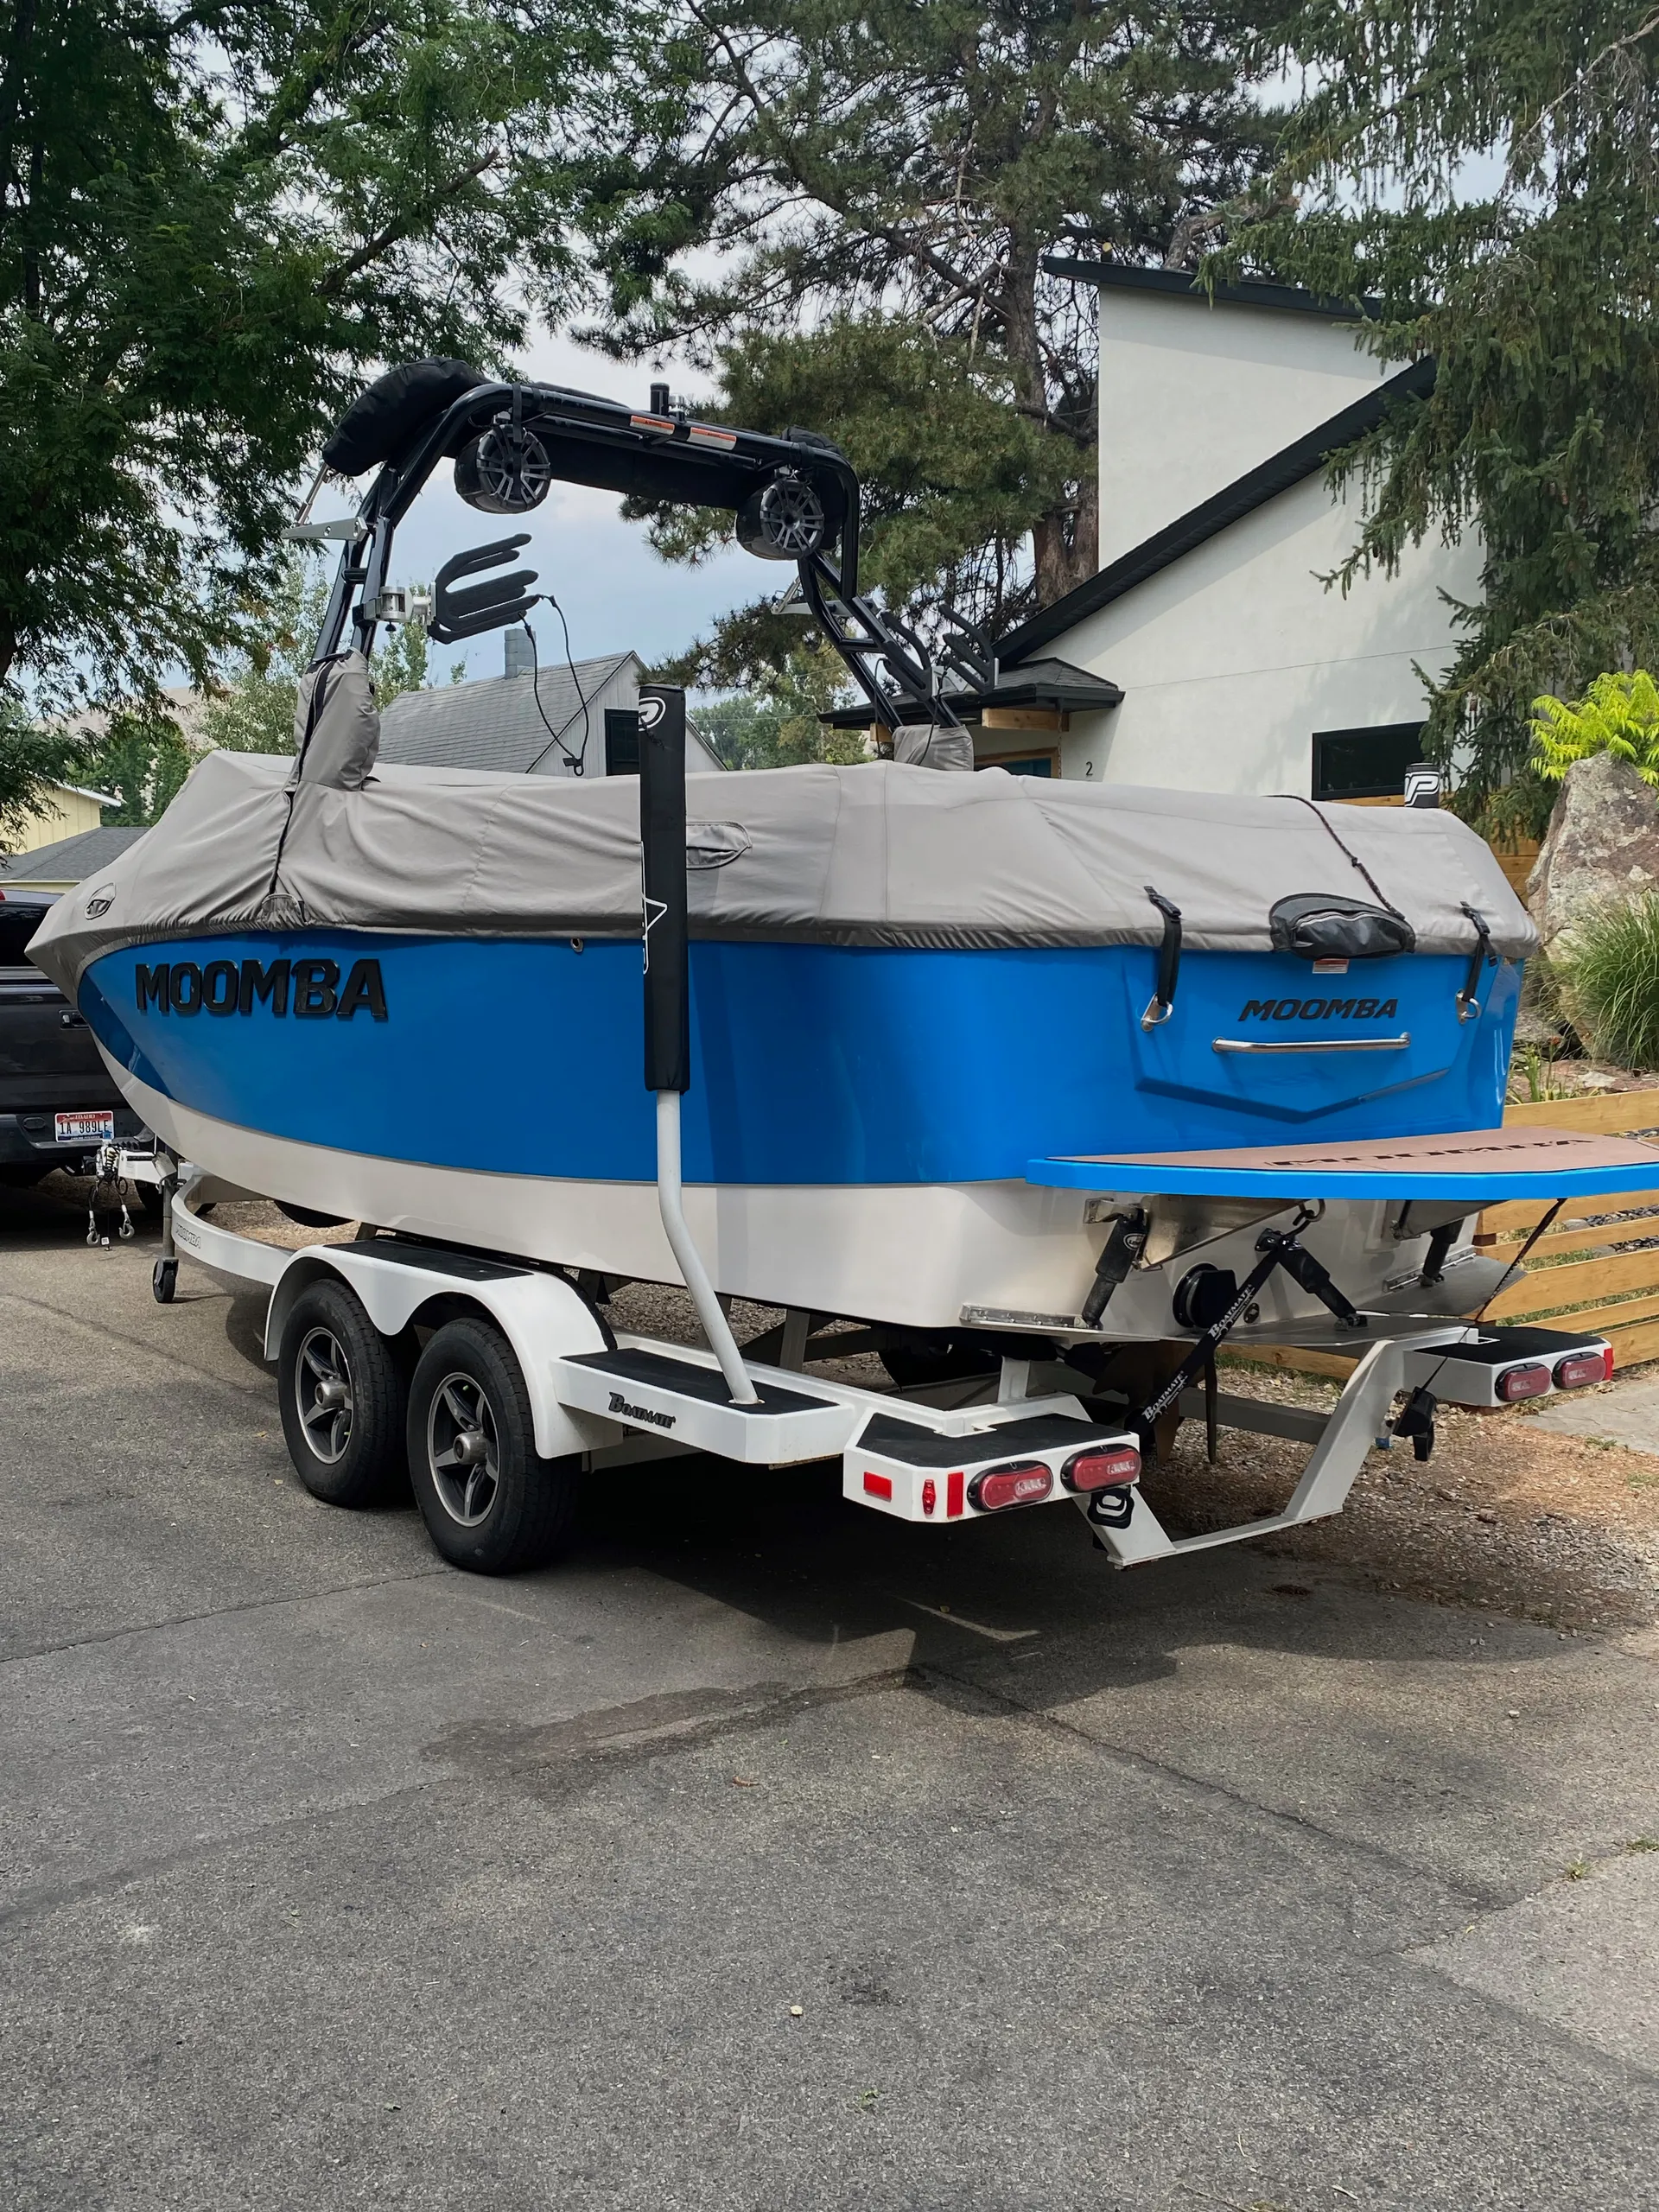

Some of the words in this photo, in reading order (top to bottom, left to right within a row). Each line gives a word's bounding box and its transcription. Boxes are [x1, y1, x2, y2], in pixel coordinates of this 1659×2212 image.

[1085, 760, 1093, 776] 2
[135, 958, 388, 1018] MOOMBA
[1237, 997, 1398, 1021] MOOMBA
